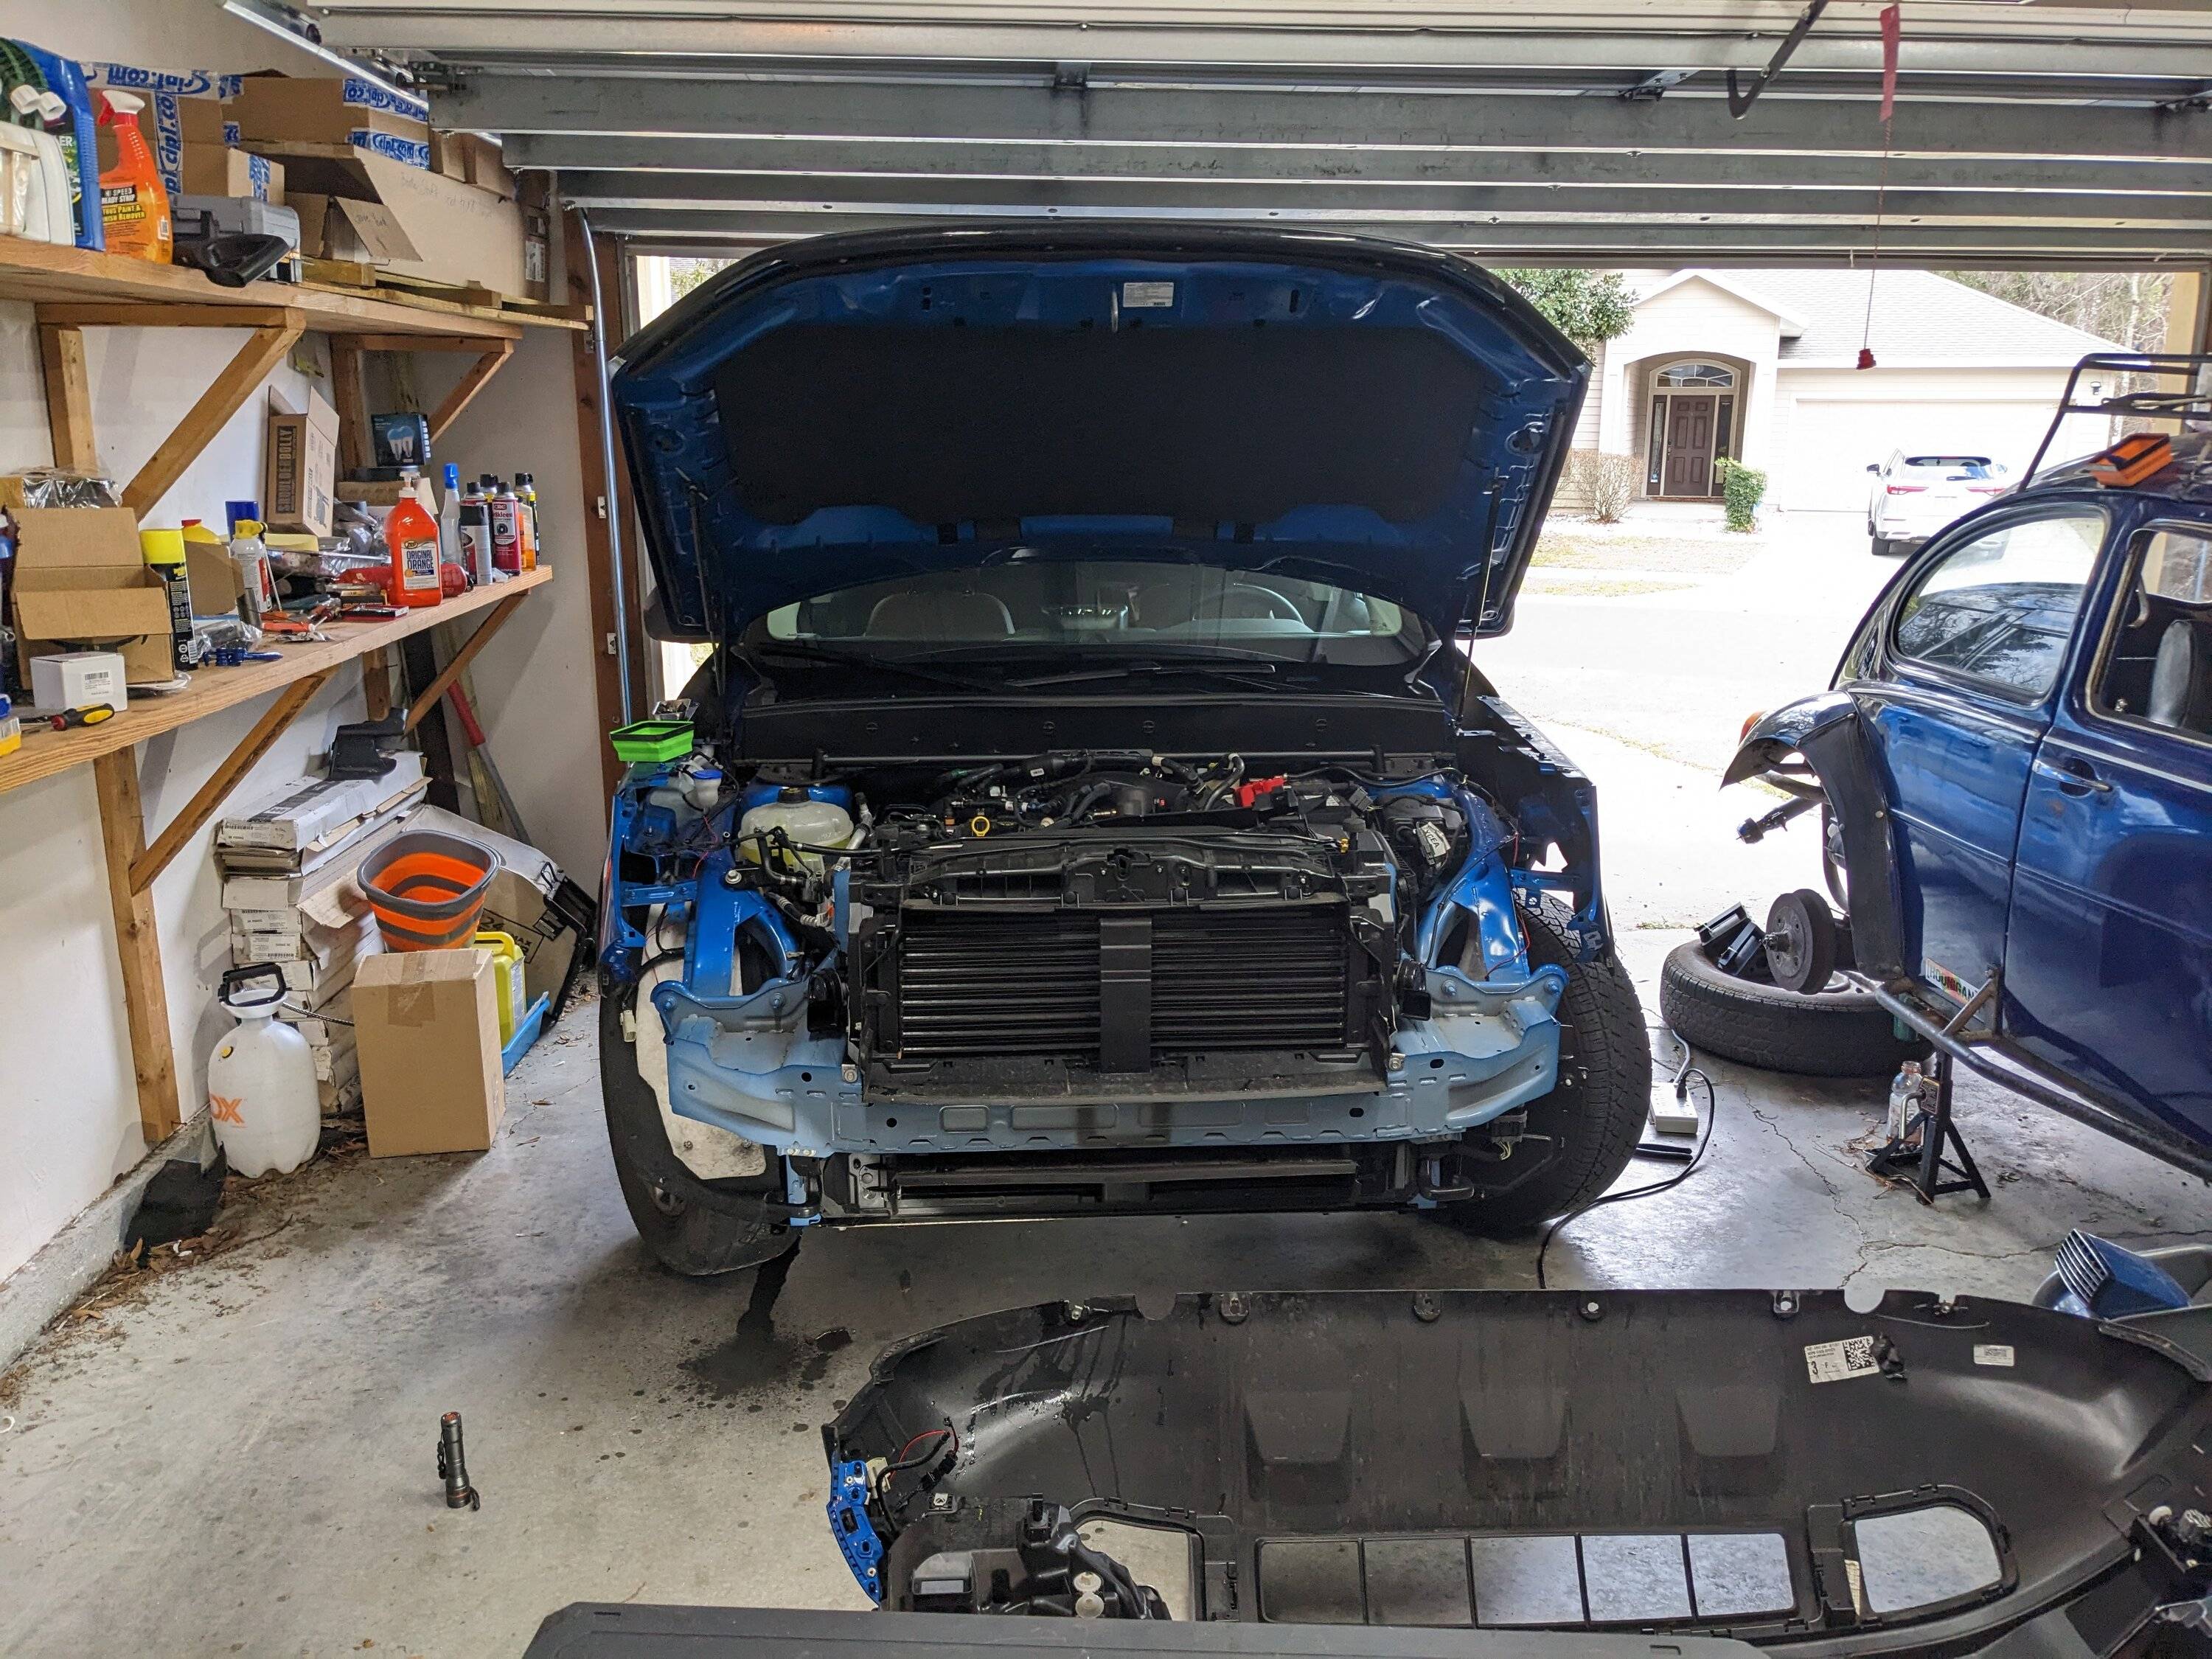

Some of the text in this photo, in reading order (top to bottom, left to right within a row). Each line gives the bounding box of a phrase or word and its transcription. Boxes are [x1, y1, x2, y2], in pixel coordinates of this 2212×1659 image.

[59, 136, 73, 147] ER
[113, 187, 133, 196] SPEED
[119, 194, 136, 202] STRIP
[278, 428, 292, 460] DOLLY
[406, 550, 434, 560] ORIGINAL
[407, 559, 434, 570] ORANGE
[1811, 1361, 1819, 1375] 3
